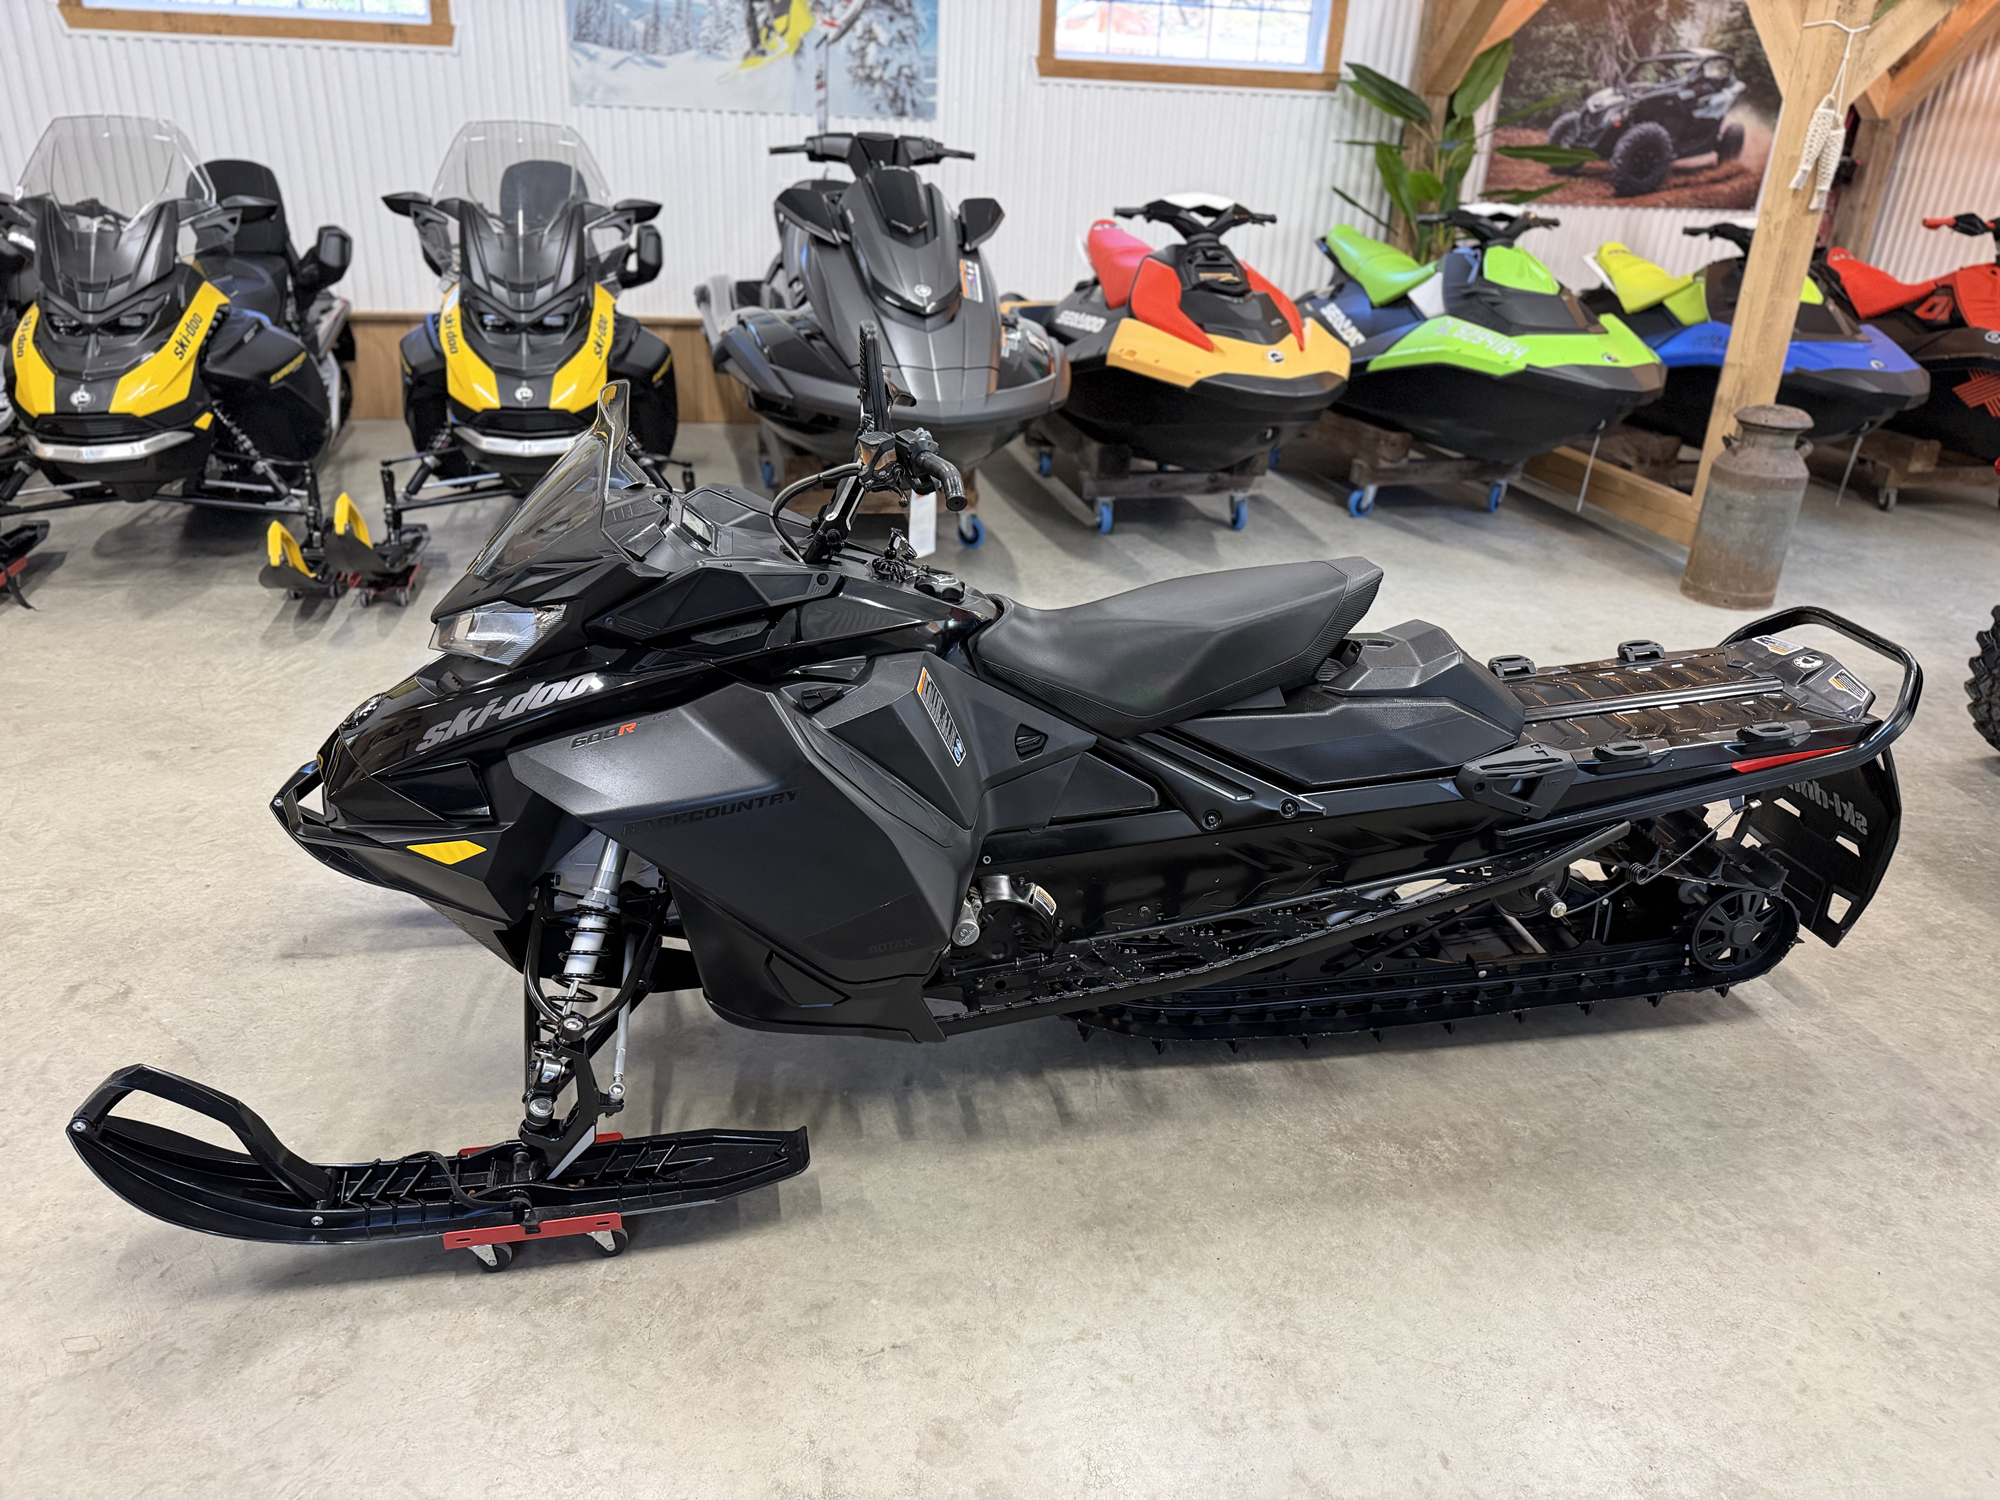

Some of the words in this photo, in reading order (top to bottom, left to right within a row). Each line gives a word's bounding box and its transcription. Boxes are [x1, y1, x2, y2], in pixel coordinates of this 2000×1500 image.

[174, 313, 203, 360] ski-doo
[594, 313, 609, 360] ski-doo
[415, 672, 597, 751] ski-doo
[570, 722, 637, 750] 600R
[868, 938, 913, 954] ROTAX
